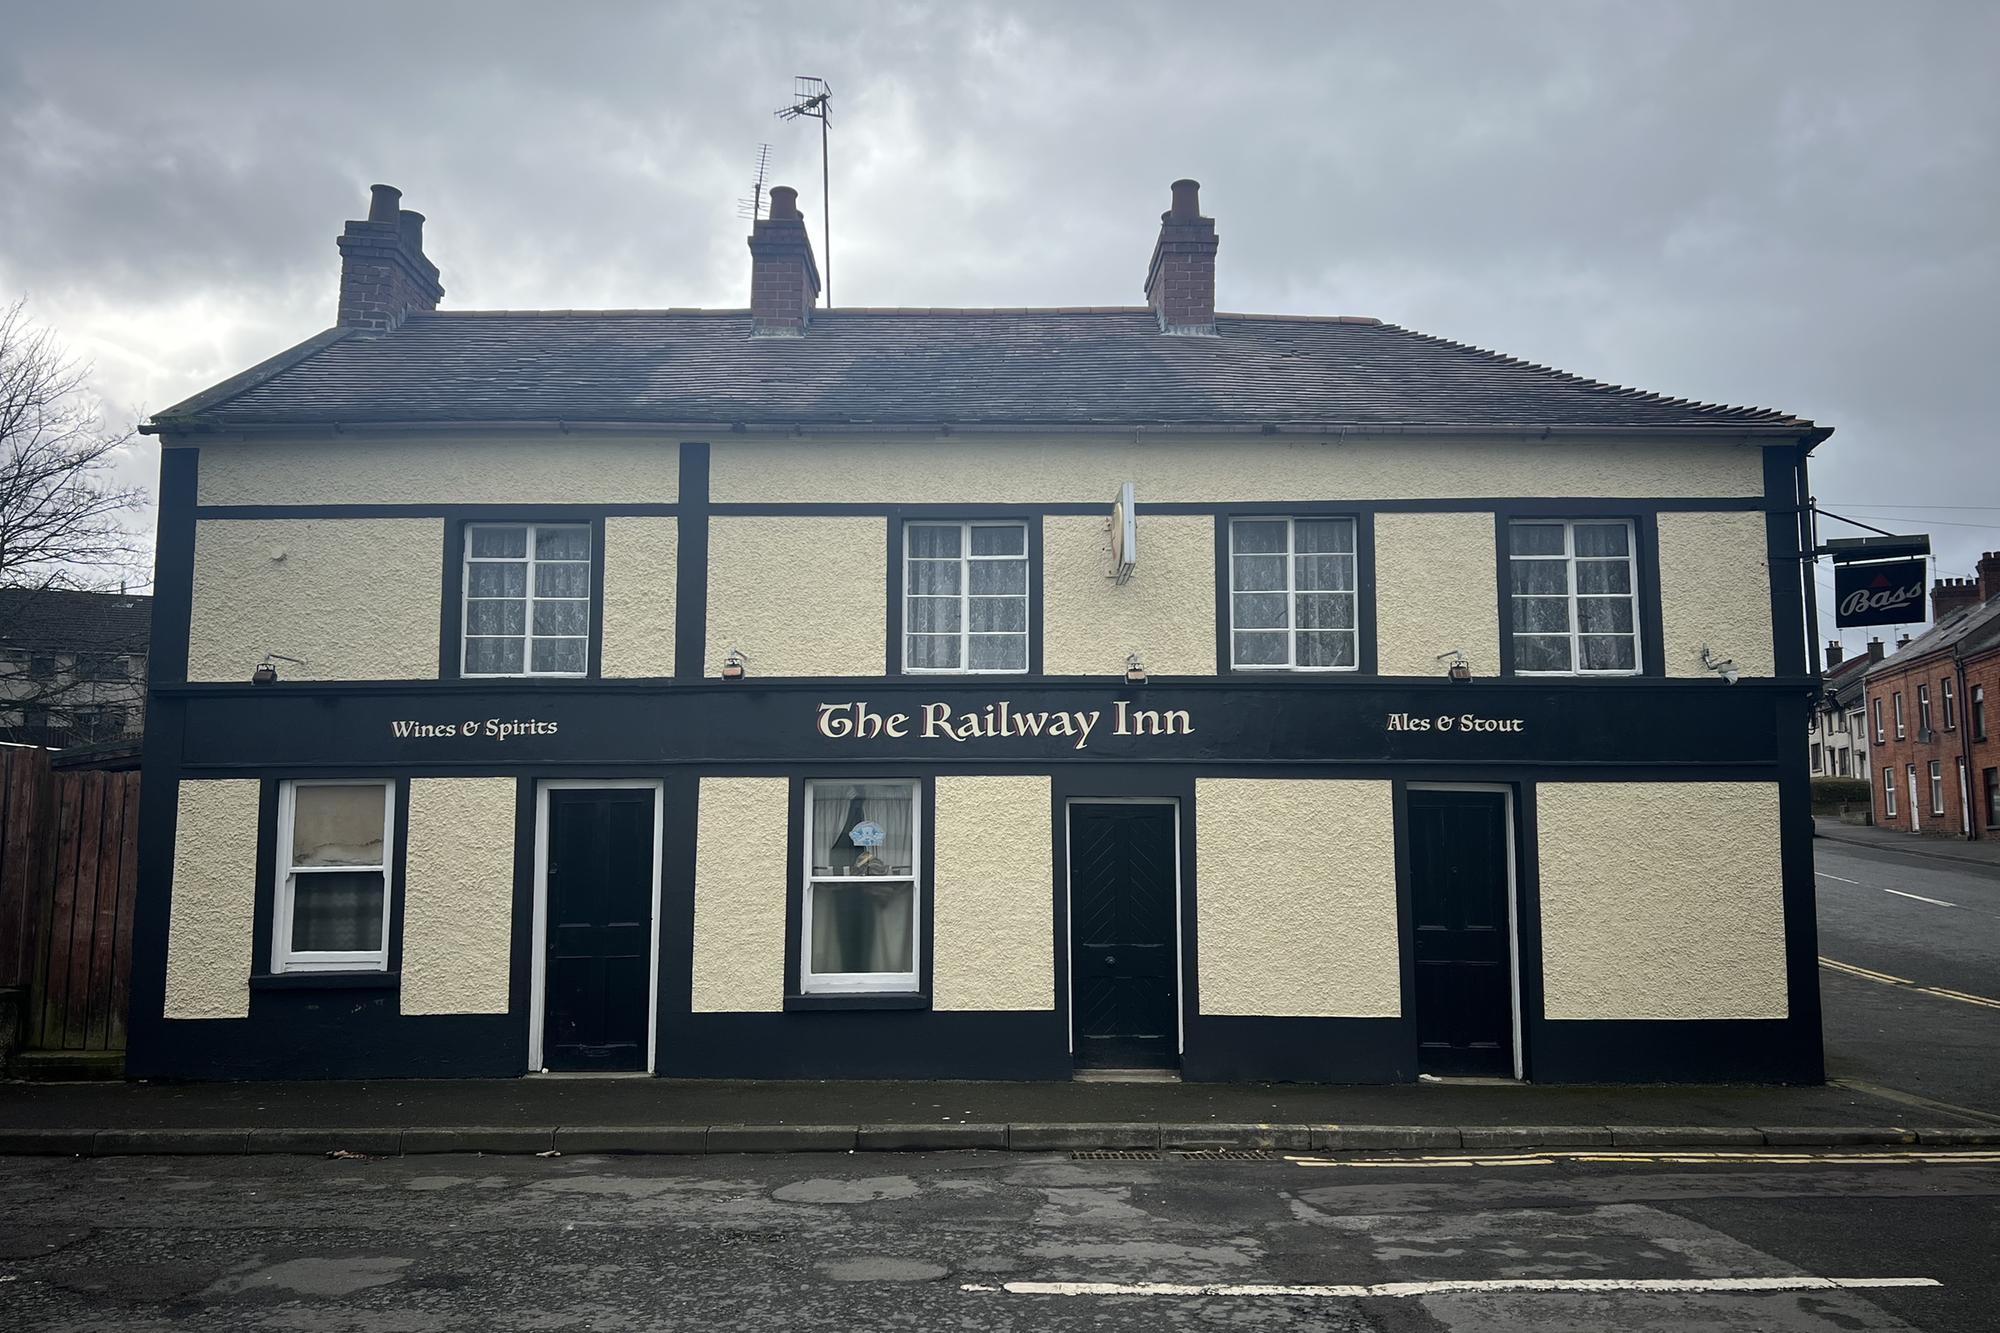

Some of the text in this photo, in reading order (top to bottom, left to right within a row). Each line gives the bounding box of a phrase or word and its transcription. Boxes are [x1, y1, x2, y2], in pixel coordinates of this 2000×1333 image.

[1840, 582, 1922, 617] Bass
[391, 717, 558, 742] Wines & Spirits
[815, 700, 1196, 750] The Railway Inn
[1387, 712, 1524, 732] Ales & Stout
